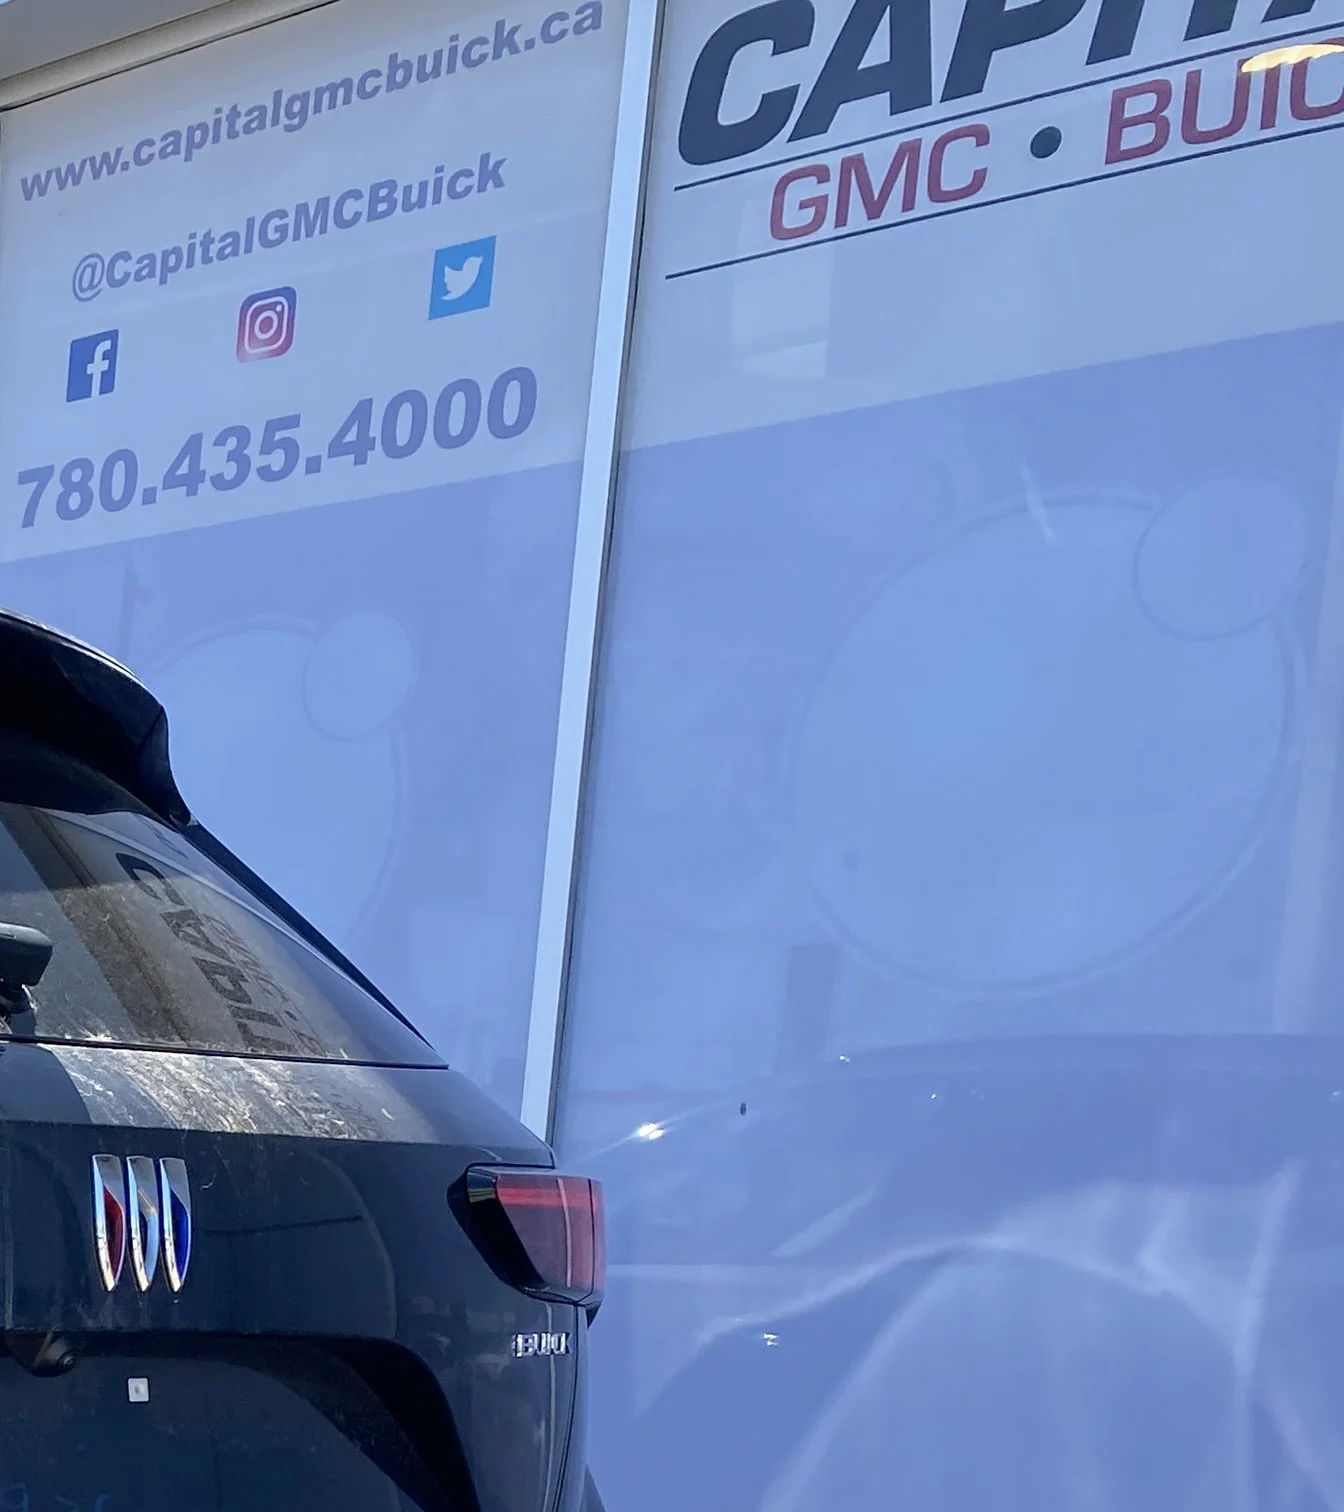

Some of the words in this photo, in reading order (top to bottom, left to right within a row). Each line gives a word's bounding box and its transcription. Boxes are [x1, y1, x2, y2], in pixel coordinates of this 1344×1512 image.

[19, 0, 603, 202] www.capitalgmcbuick.ca
[72, 151, 506, 302] @CapitalGMCBuick
[769, 123, 991, 241] GMC
[17, 366, 538, 529] 780.435.4000
[515, 1332, 574, 1357] BUICK
